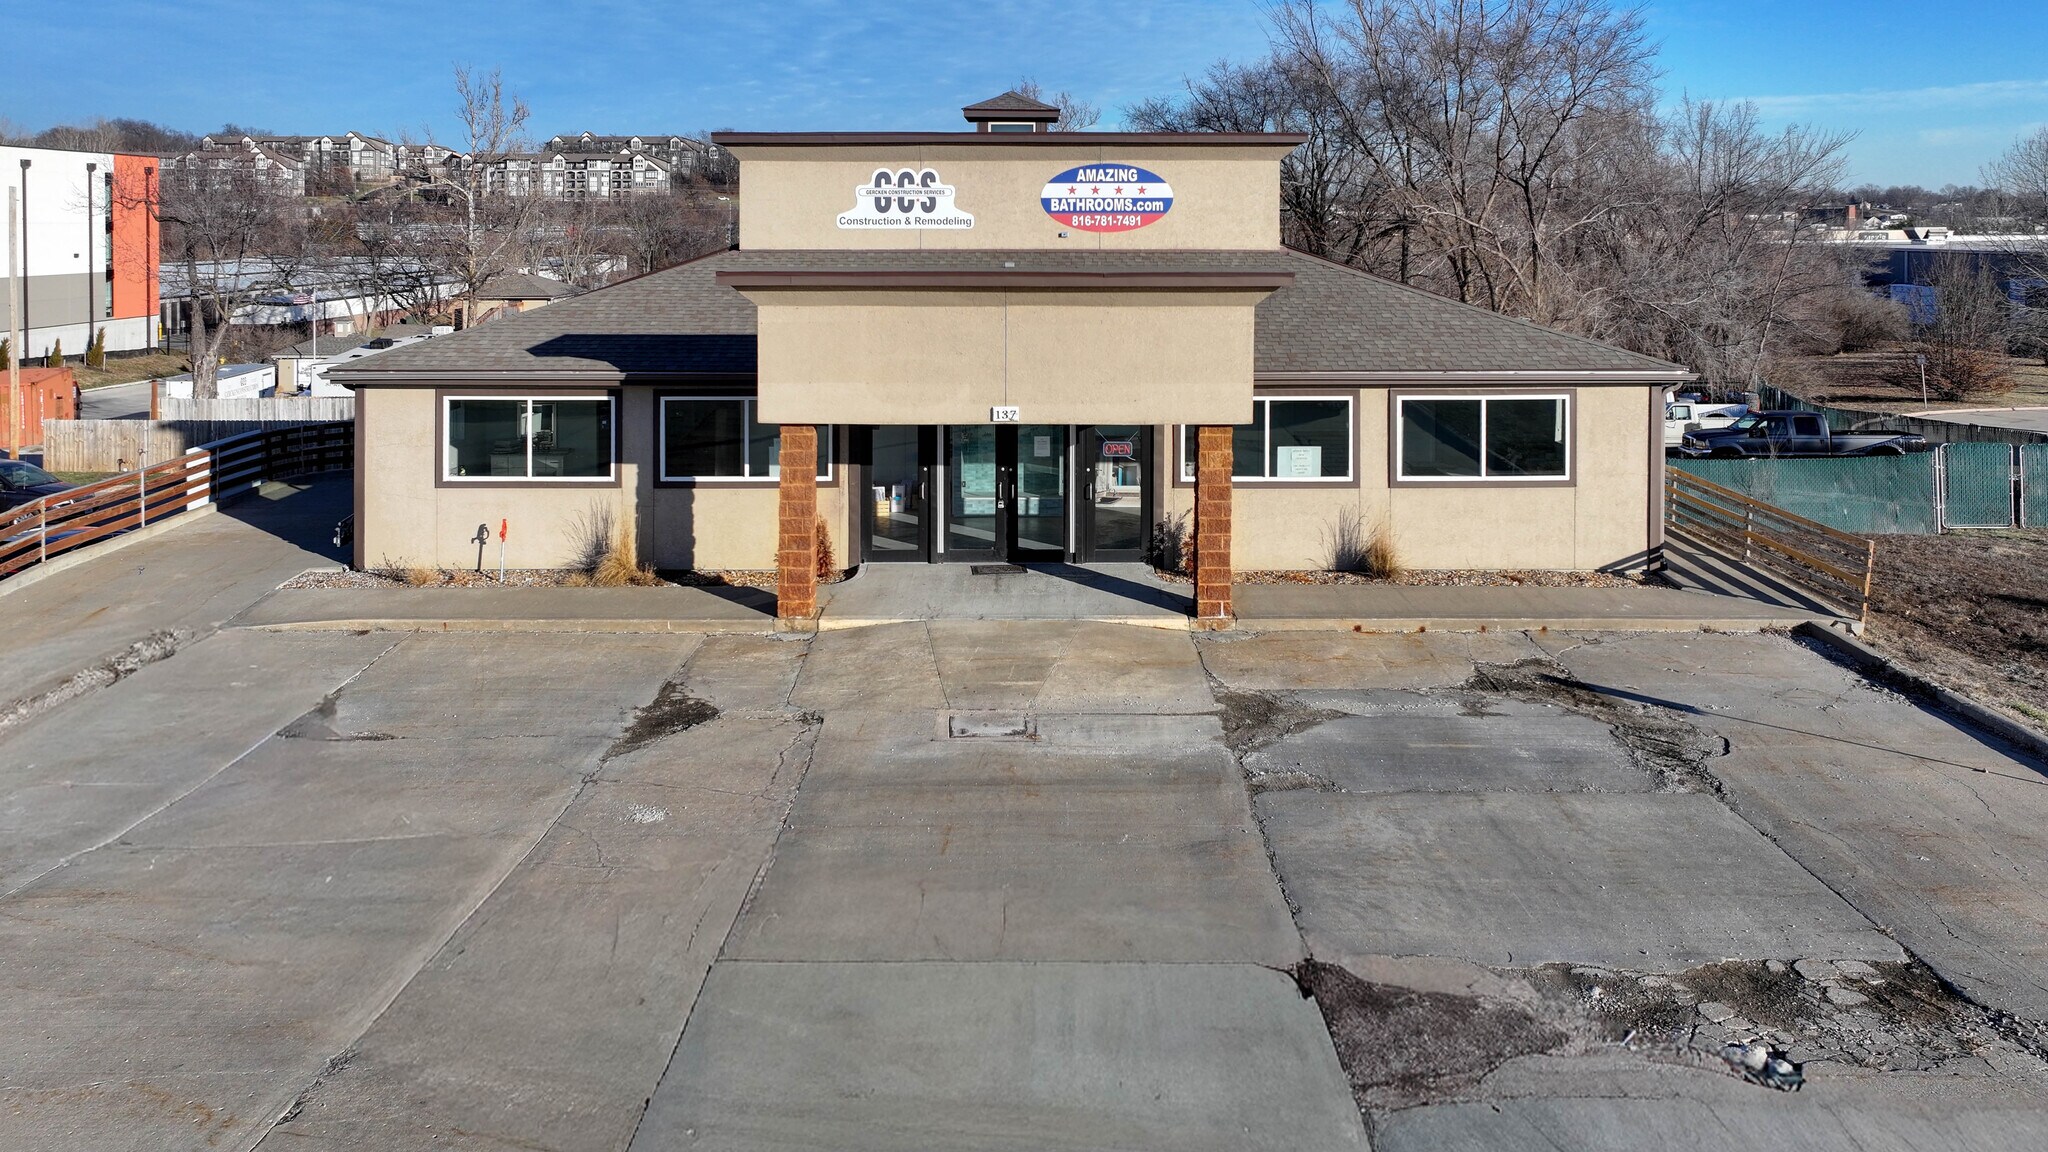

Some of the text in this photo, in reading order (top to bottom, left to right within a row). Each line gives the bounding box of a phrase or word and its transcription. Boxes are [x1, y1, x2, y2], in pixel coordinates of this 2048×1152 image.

[1076, 168, 1138, 182] AMAZING
[1050, 198, 1164, 212] BATHROOMS.com
[839, 216, 972, 228] Construction & Remodeling
[1072, 215, 1141, 227] 816-781-7491
[996, 410, 1016, 421] 137
[1105, 444, 1130, 455] OPEN
